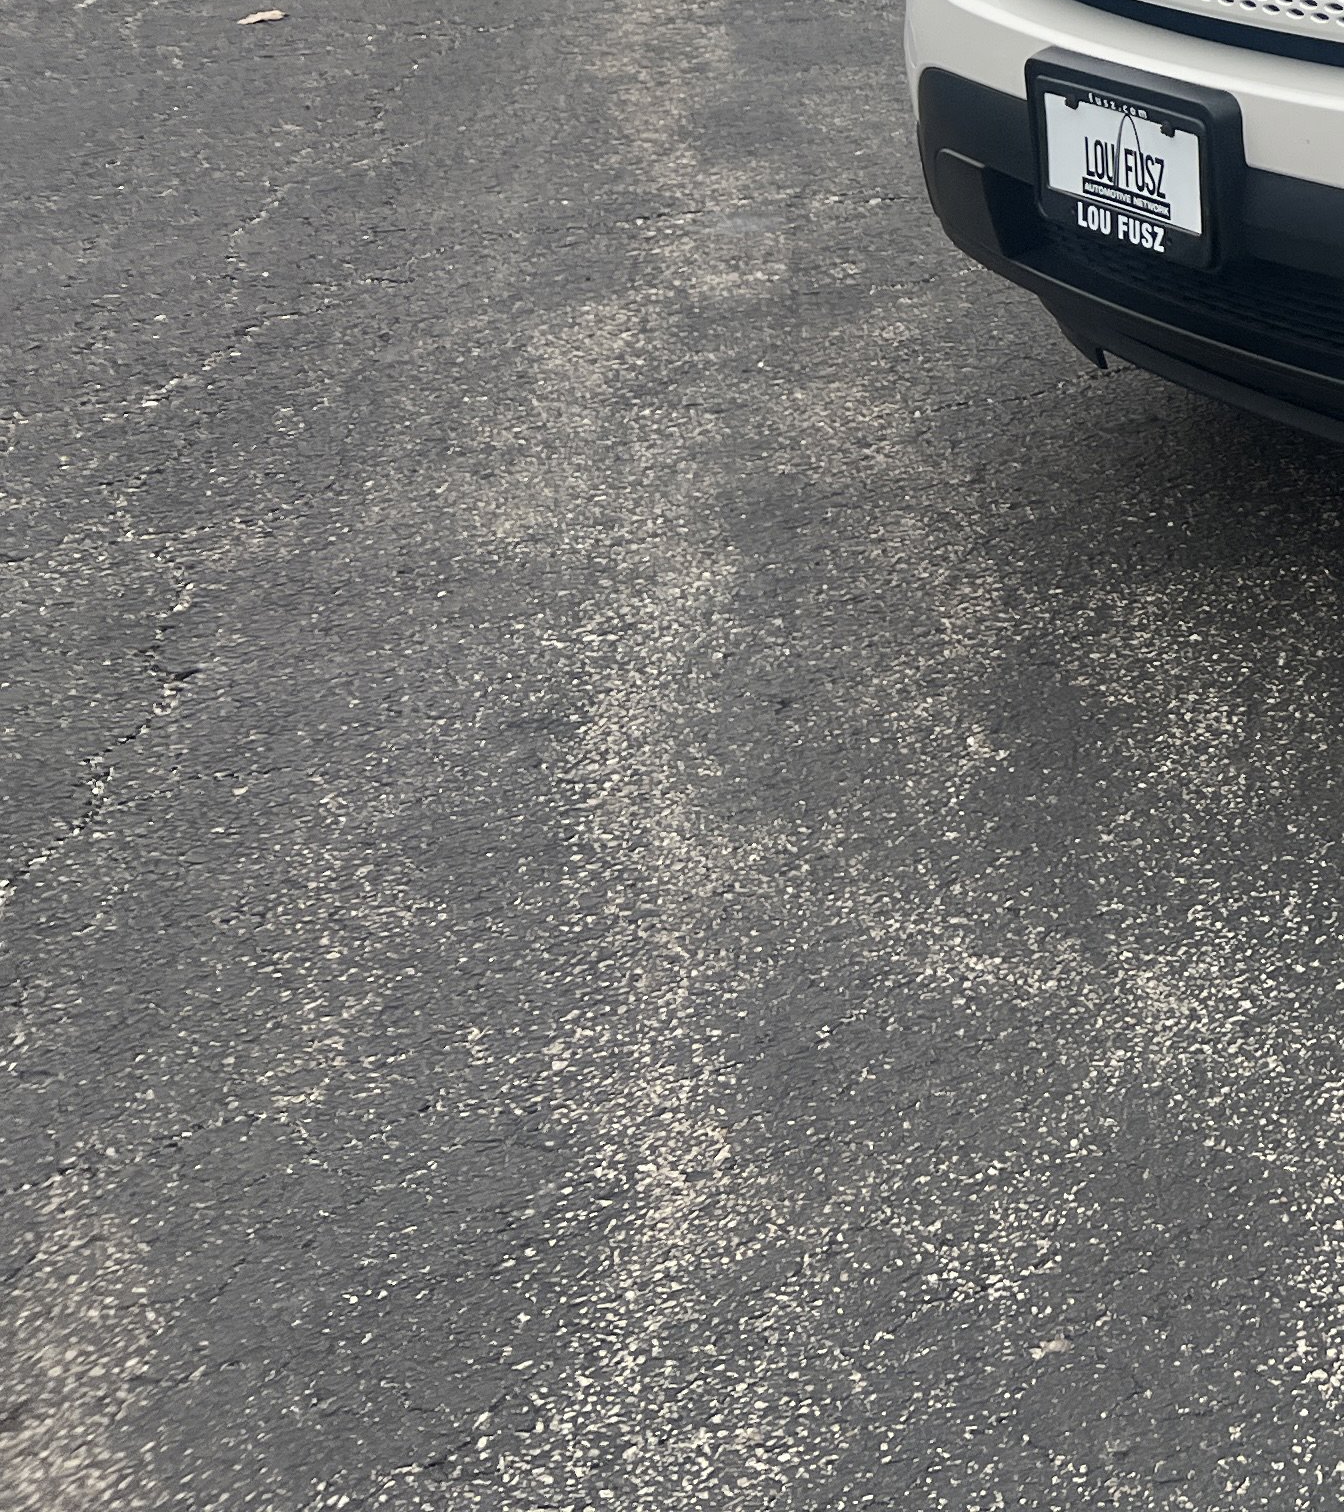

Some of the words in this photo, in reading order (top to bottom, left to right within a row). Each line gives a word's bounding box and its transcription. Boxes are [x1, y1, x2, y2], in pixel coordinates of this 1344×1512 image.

[1088, 92, 1148, 119] fusz.com
[1084, 136, 1115, 183] LOU
[1124, 148, 1166, 199] FUSZ
[1084, 182, 1132, 204] AUTOMOTIVE
[1132, 197, 1170, 217] NETWORK
[1077, 201, 1112, 236] LOU
[1117, 214, 1165, 253] FUSZ
